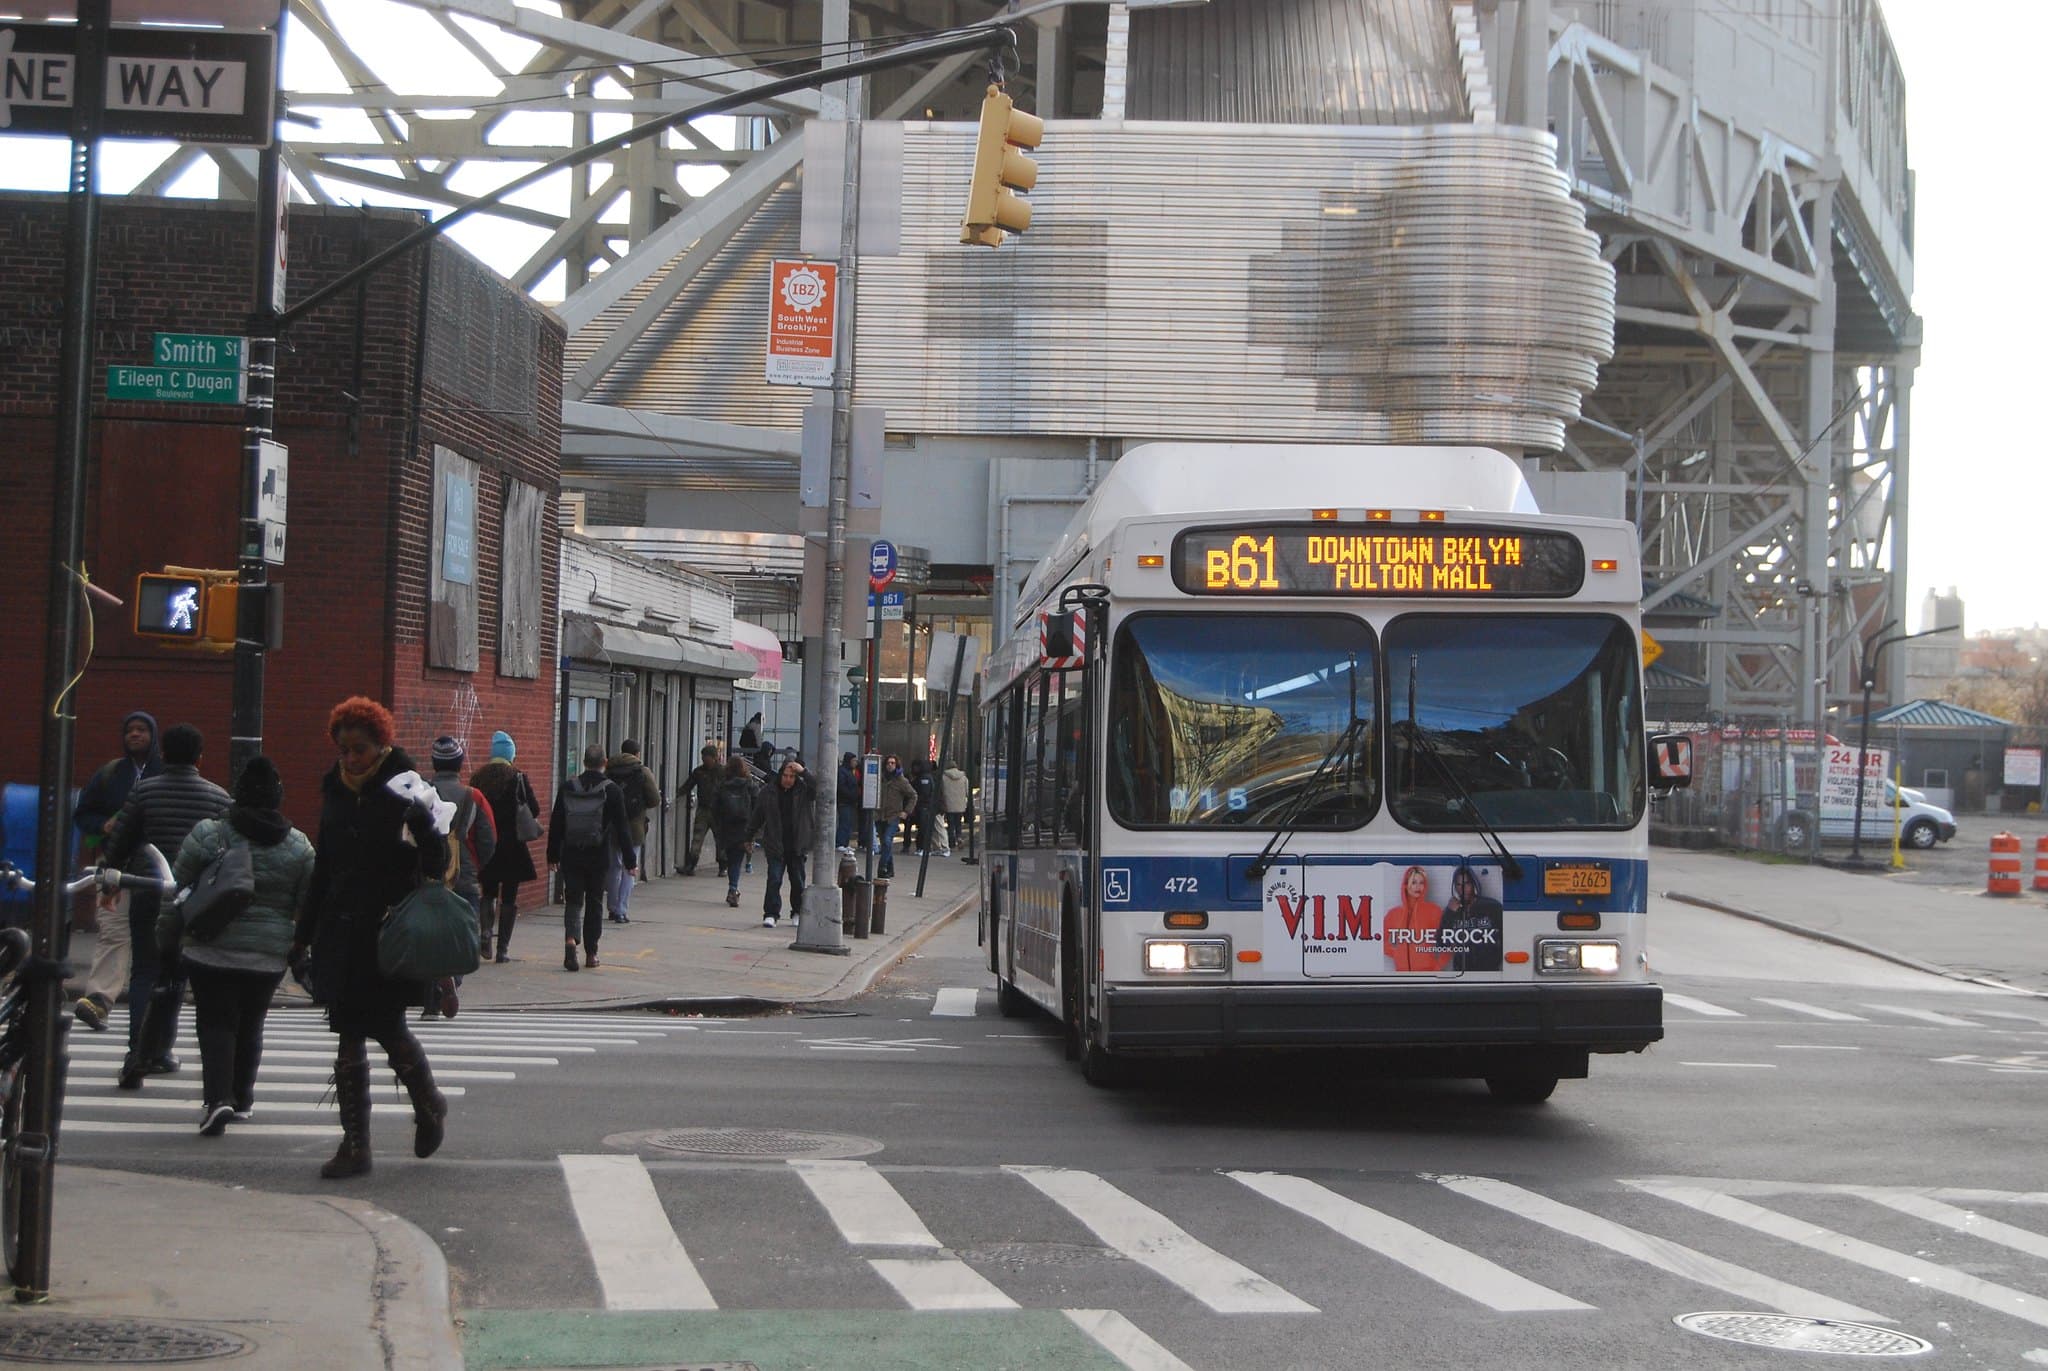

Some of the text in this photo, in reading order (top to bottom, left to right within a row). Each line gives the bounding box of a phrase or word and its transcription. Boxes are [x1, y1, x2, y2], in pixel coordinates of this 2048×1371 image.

[5, 58, 224, 108] NE WAY
[792, 283, 815, 296] IBZ
[777, 313, 827, 324] South West
[777, 322, 818, 333] Brooklyn
[776, 338, 804, 346] Industrial
[776, 345, 820, 354] Business Zone
[160, 337, 216, 363] Smith
[225, 341, 238, 357] St
[119, 369, 232, 393] Eileen C Dugan
[156, 388, 194, 399] Boulevard
[448, 534, 469, 558] FOR SALE
[1307, 536, 1520, 565] DOWNTOWN BKLYN
[1207, 535, 1279, 588] B61
[1335, 565, 1492, 590] FULTON MALL
[883, 594, 898, 604] B61
[1831, 750, 1850, 764] 24
[1829, 766, 1850, 776] ACTIVE
[1165, 877, 1198, 892] 472
[1266, 881, 1298, 903] WINNING TEAM
[1275, 895, 1382, 941] V.I.M.
[1388, 928, 1497, 944] TRUE ROCK
[1304, 945, 1347, 953] VIM.com
